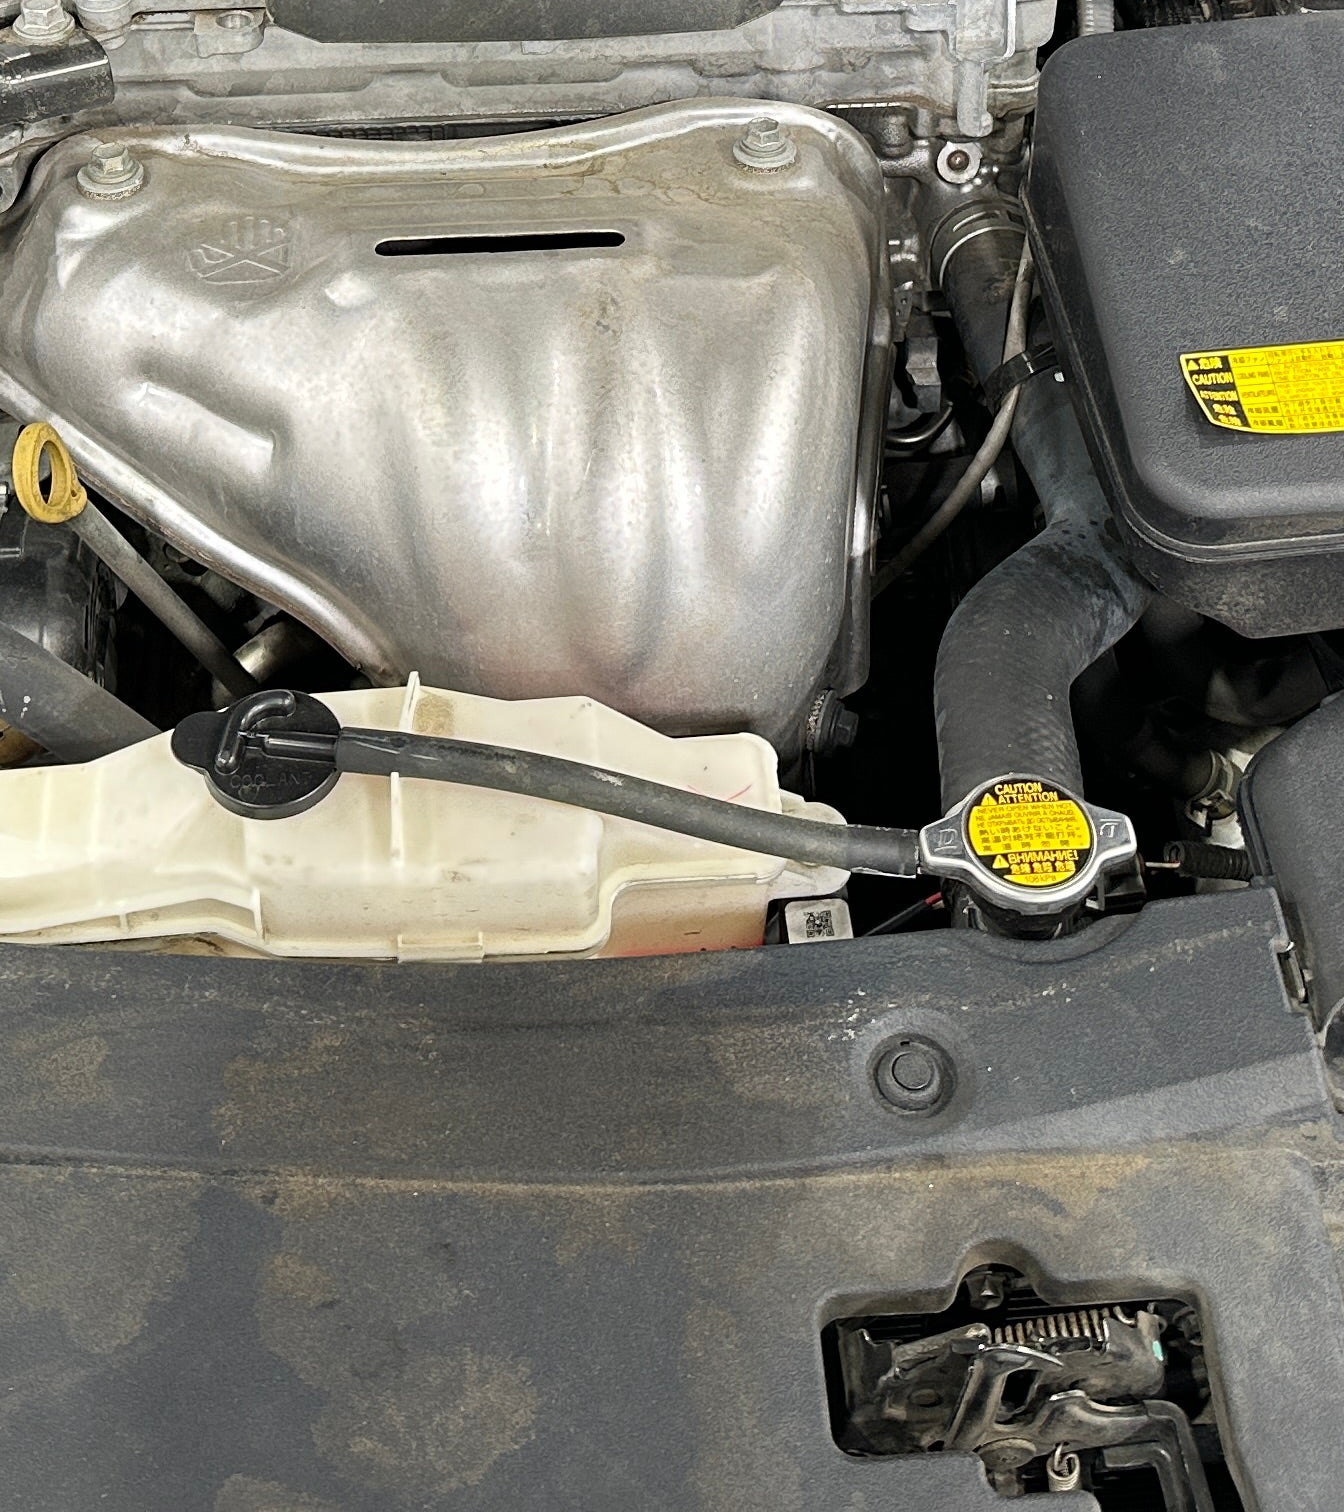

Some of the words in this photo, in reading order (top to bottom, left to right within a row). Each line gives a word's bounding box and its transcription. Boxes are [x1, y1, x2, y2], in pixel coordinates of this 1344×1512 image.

[1192, 372, 1233, 385] CAUTION
[994, 782, 1043, 795] CAUTION
[998, 791, 1059, 805] ATTENTION
[977, 806, 1004, 814] NEVER
[1006, 804, 1029, 813] OPEN
[1031, 803, 1054, 811] WHEN
[1007, 849, 1079, 864] ВНИМАНИЕ!
